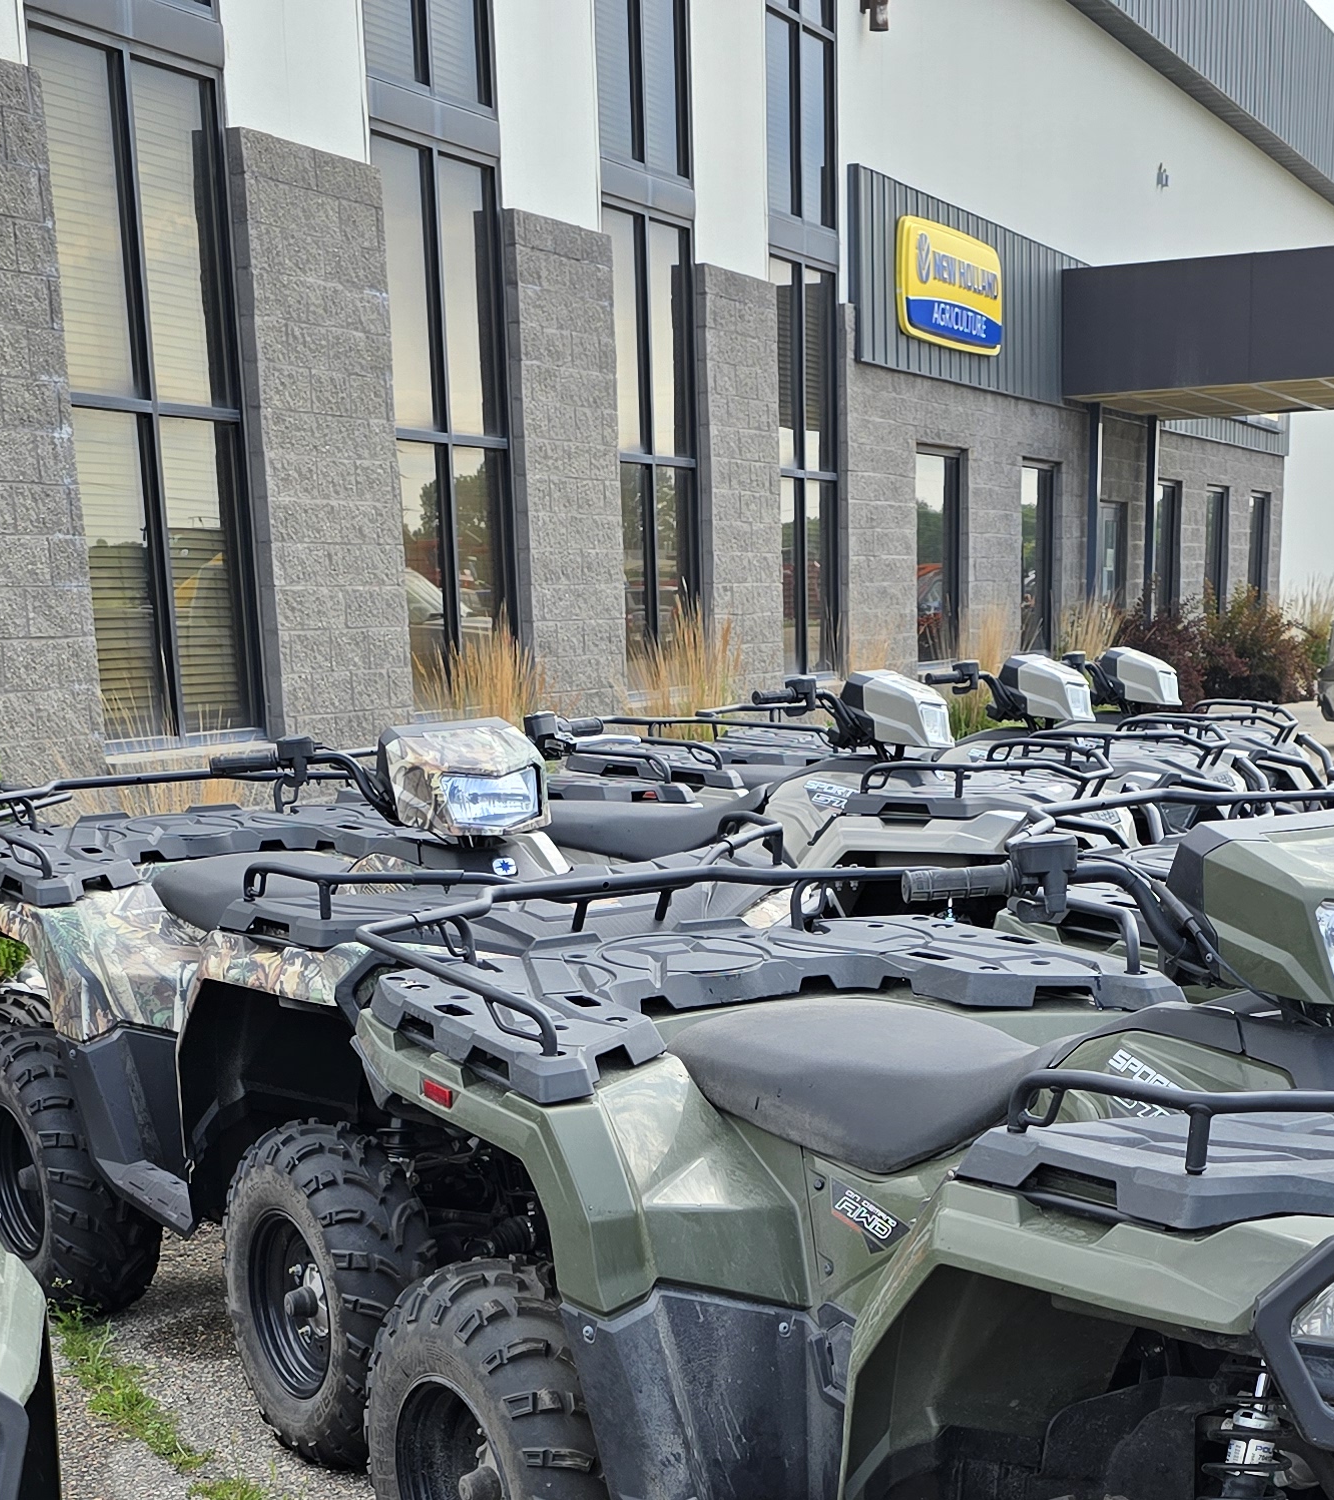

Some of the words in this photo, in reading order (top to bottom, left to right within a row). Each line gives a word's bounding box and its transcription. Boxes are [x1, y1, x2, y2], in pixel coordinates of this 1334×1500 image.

[932, 249, 957, 287] NEW
[957, 258, 999, 301] HOLLAND
[932, 301, 987, 339] AGRICULTURE
